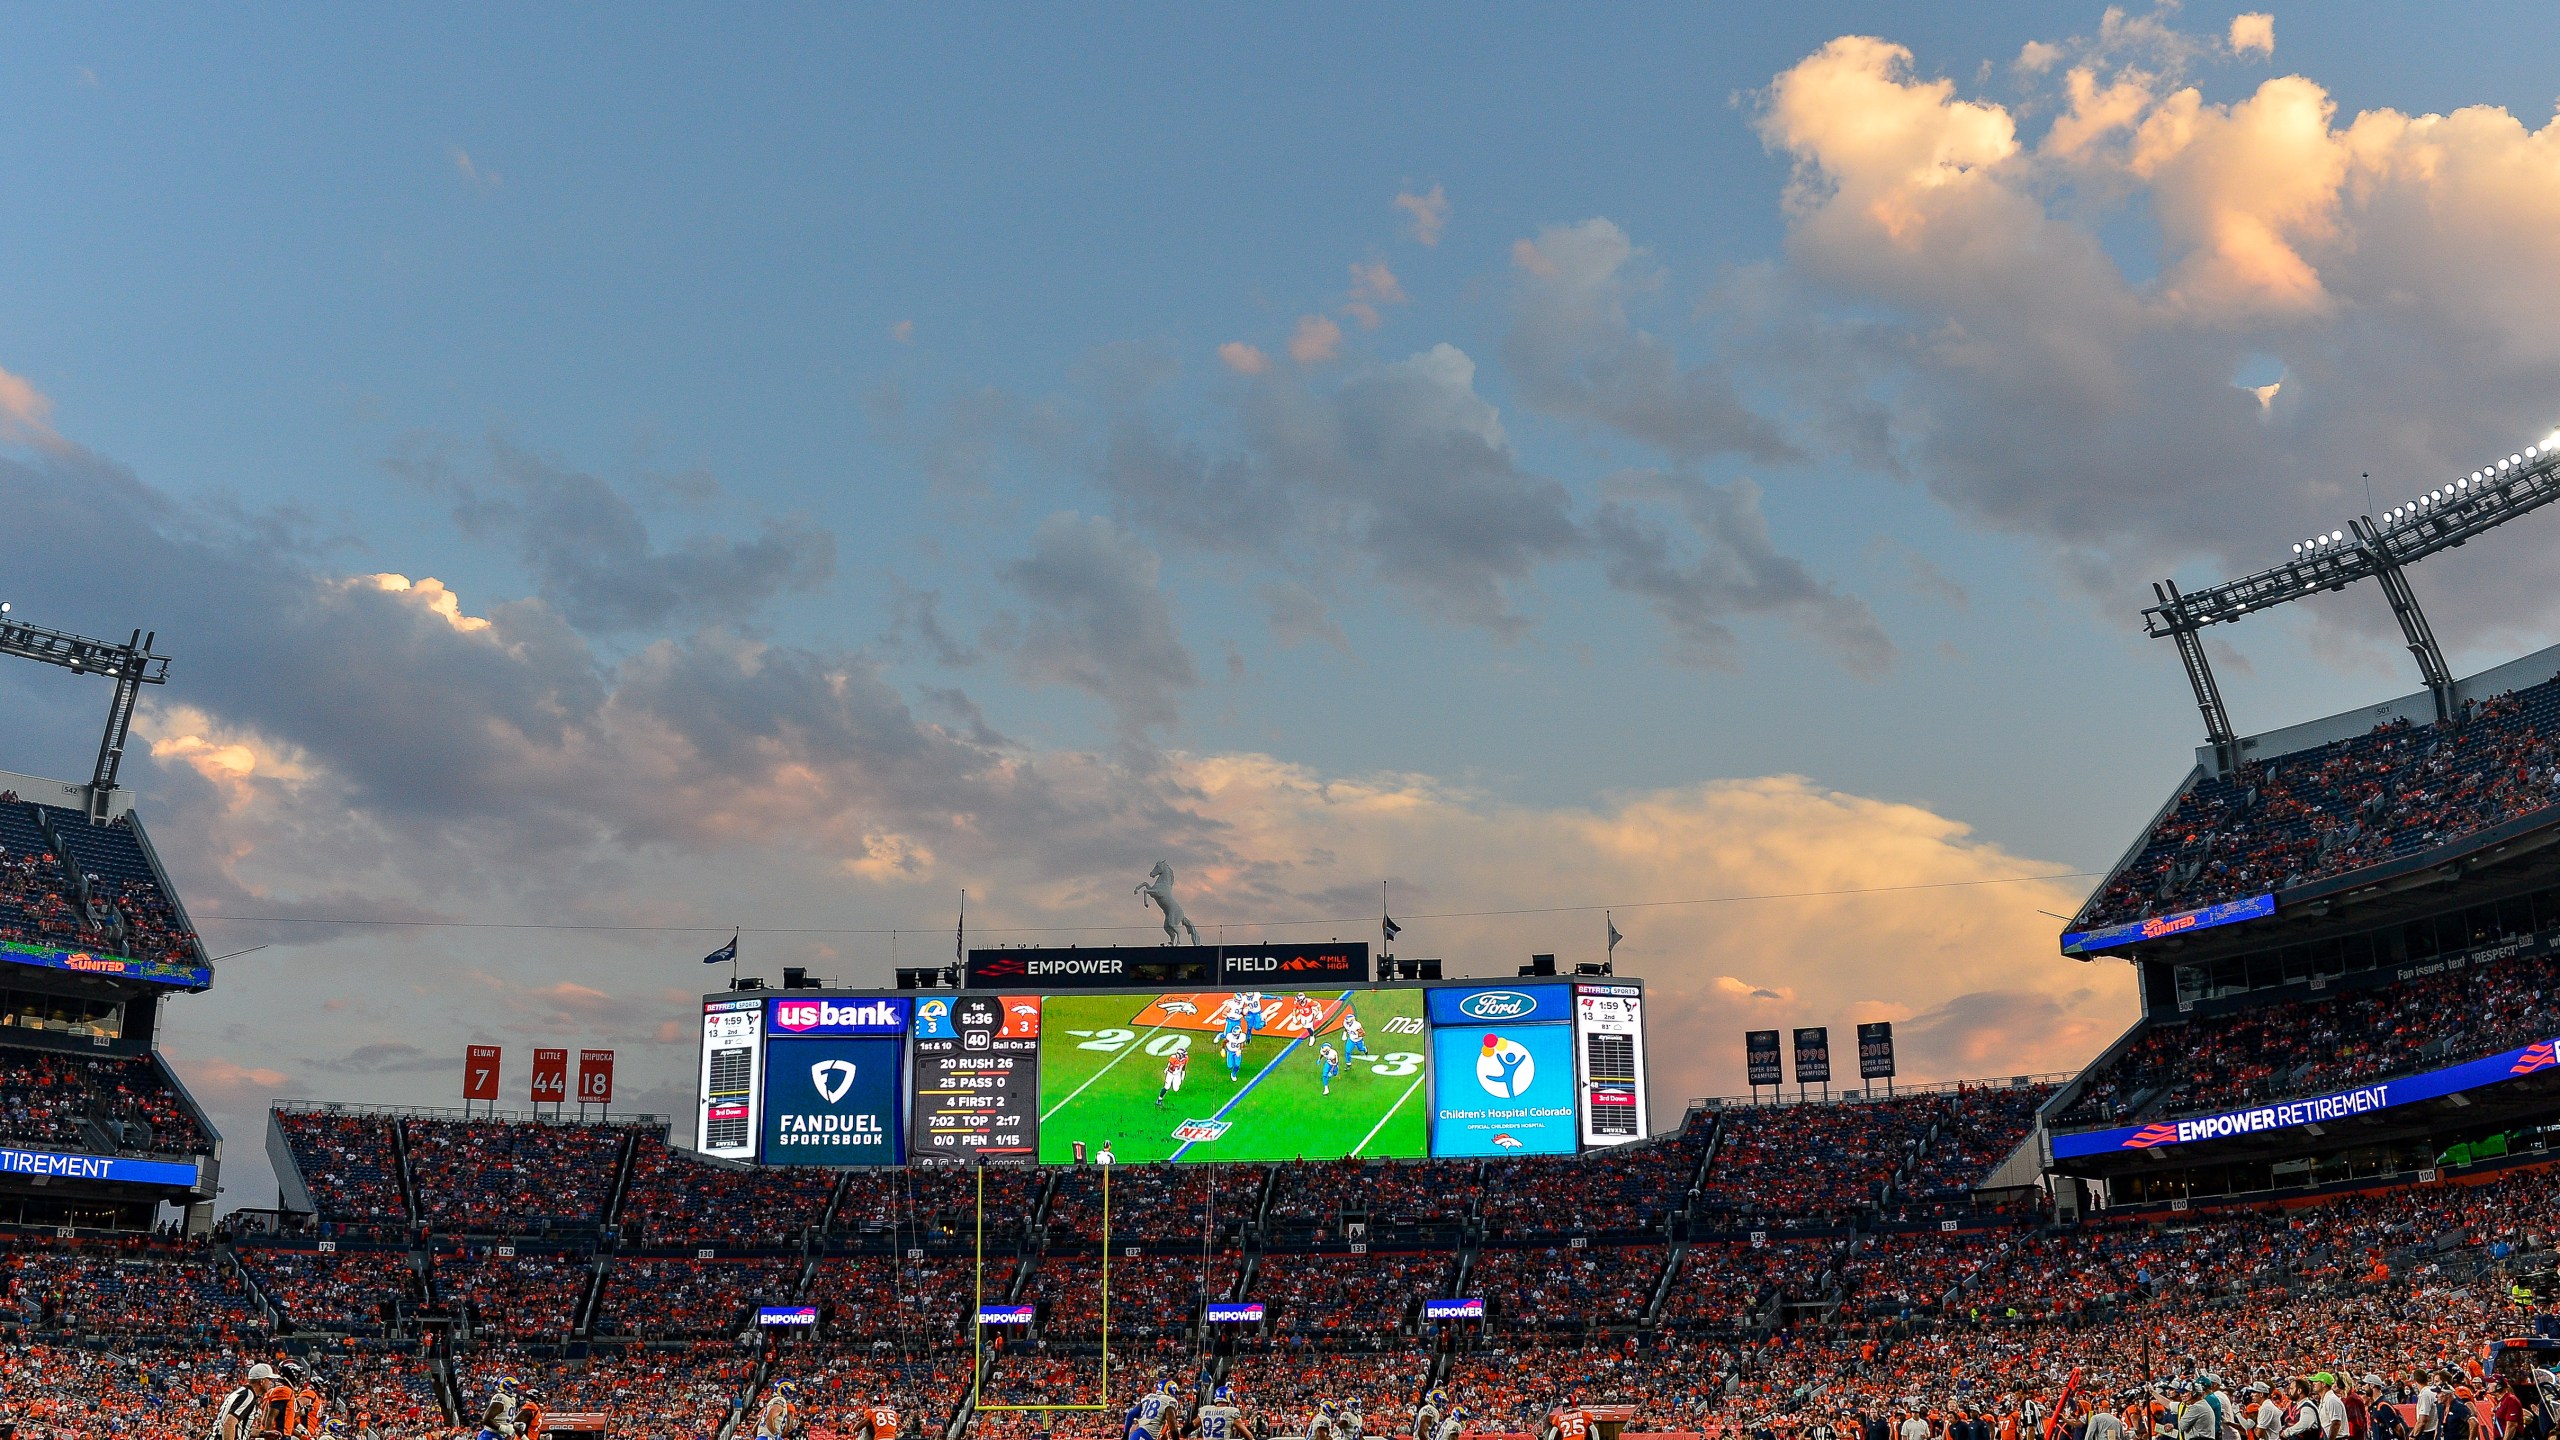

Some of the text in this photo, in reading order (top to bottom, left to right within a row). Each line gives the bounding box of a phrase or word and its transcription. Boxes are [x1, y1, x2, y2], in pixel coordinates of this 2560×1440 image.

[2377, 706, 2390, 715] 501
[64, 786, 78, 795] 542
[2153, 916, 2196, 936] UNITED
[1327, 955, 1347, 963] MILE
[79, 960, 125, 972] UNITED
[1027, 957, 1278, 975] EMPOWER FIELD
[2397, 969, 2414, 980] Fan
[2416, 962, 2445, 977] issues
[2448, 956, 2465, 970] text
[2311, 980, 2325, 989] 301
[1613, 987, 1636, 995] SPORTS
[738, 1001, 759, 1009] SPORTS
[971, 1003, 985, 1011] 1st
[1474, 995, 1522, 1015] Ford
[1599, 1001, 1619, 1010] 1:59
[2180, 1002, 2193, 1011] 300
[725, 1016, 742, 1026] 1:59
[962, 1013, 993, 1024] 5:36
[1583, 1012, 1594, 1021] 13
[1628, 1014, 1634, 1022] 2
[749, 1026, 755, 1035] 2
[928, 1022, 937, 1033] 3
[1020, 1021, 1029, 1032] 3
[709, 1029, 718, 1038] 13
[968, 1034, 987, 1046] 40
[920, 1042, 952, 1050] 1st & 10
[993, 1041, 1036, 1050] Ball On 25
[1861, 1043, 1890, 1057] 2015
[473, 1048, 495, 1058] ELWAY
[540, 1052, 561, 1060] LITTLE
[581, 1053, 613, 1061] TRIPUCKA
[1749, 1051, 1778, 1064] 1997
[1796, 1048, 1826, 1061] 1998
[940, 1058, 1013, 1069] 20 RUSH 26
[1749, 1066, 1764, 1074] SUPER
[1798, 1069, 1828, 1077] CHAMPIONS
[1862, 1065, 1891, 1073] CHAMPIONS
[474, 1069, 490, 1091] 7
[1751, 1072, 1780, 1080] CHAMPIONS
[533, 1072, 564, 1093] 44
[584, 1073, 607, 1095] 18
[940, 1077, 1006, 1088] 25 PASS 0
[946, 1096, 1005, 1107] 4 FIRST 2
[1440, 1106, 1572, 1119] Children's Hospital Colorado
[2178, 1085, 2388, 1142] EMPOWER RETIREMENT
[780, 1115, 882, 1132] FANDUEL
[928, 1115, 1021, 1126] 7:02 TOP 2:17
[780, 1134, 883, 1145] SPORTSBOOK
[933, 1135, 1020, 1146] 0/0 PEN 1/15
[2420, 1170, 2434, 1181] 100
[2172, 1200, 2187, 1210] 100
[1943, 1221, 1957, 1230] 135
[58, 1228, 73, 1237] 128
[320, 1242, 334, 1250] 129
[499, 1247, 514, 1255] 129
[1352, 1244, 1366, 1252] 133
[1208, 1311, 1264, 1321] EMPOWER
[1427, 1307, 1483, 1318] EMPOWER
[760, 1315, 815, 1324] EMPOWER
[979, 1313, 1033, 1323] EMPOWER
[875, 1412, 897, 1427] 85
[1203, 1417, 1226, 1438] 92
[1560, 1419, 1586, 1438] 25
